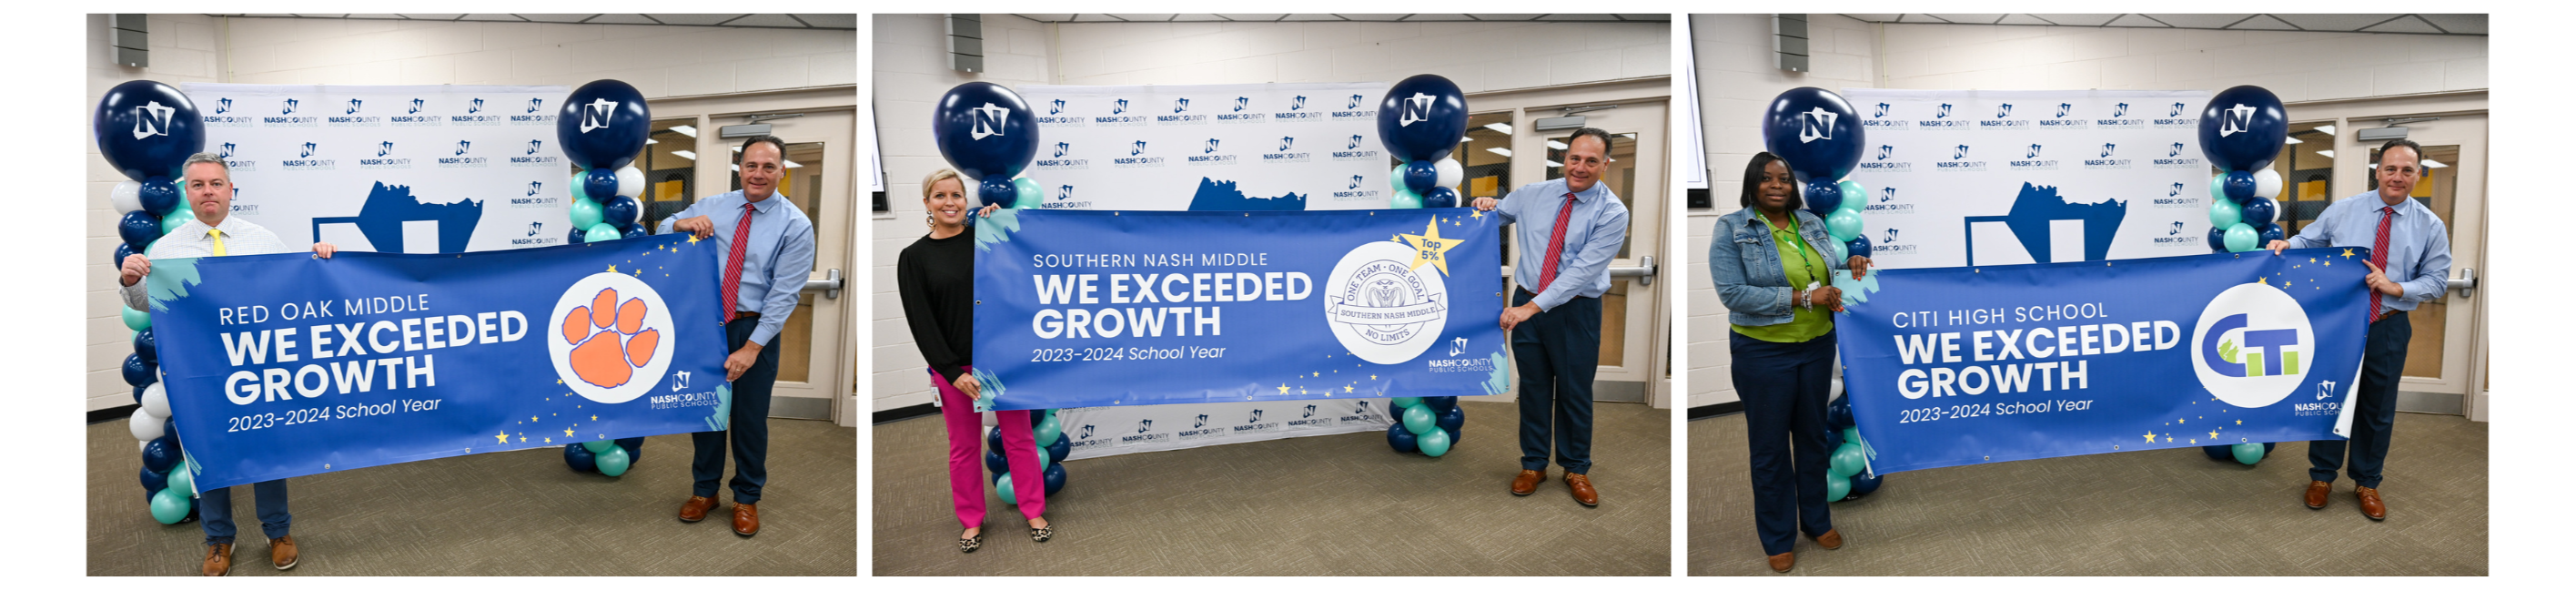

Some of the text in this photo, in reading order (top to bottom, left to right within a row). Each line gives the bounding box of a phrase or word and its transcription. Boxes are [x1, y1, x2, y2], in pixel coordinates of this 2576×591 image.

[1421, 239, 1441, 251] Top
[1034, 253, 1268, 268] SOUTHERN NASH MIDDLE
[1421, 250, 1440, 261] 5%
[1032, 271, 1314, 304] WE EXCEEDED
[1347, 263, 1425, 301] ONE TEAM ONE GOAL
[220, 293, 429, 326] RED OAK MIDDLE
[1340, 310, 1382, 320] SOUTHERN
[1407, 306, 1436, 318] MIDDLE
[1893, 302, 2107, 328] CITI HIGH SCHOOL
[1032, 306, 1221, 339] GROWTH
[220, 310, 528, 366] WE EXCEEDED
[1365, 329, 1410, 341] NO LIMITS
[1893, 321, 2180, 364] WE EXCEEDED
[1030, 346, 1227, 362] 2023-2024 School Year
[1429, 358, 1491, 367] NASHCOUNTY
[226, 353, 435, 406] GROWTH
[1898, 359, 2087, 399] GROWTH
[651, 392, 716, 404] NASHCOUNTY
[681, 399, 718, 408] SCHOOLS
[1900, 399, 2093, 424] 2023-2024 School Year
[2295, 402, 2343, 412] NASHCOU
[227, 399, 442, 432] 2023-2024 School Year
[1288, 418, 1332, 426] NASHCOUNTY
[1179, 428, 1225, 436] NASHCOUNTY
[1235, 423, 1278, 432] NASHCOUNTY
[1070, 438, 1112, 447] ASHCOUNTY
[1123, 433, 1169, 442] NASHCOUNTY
